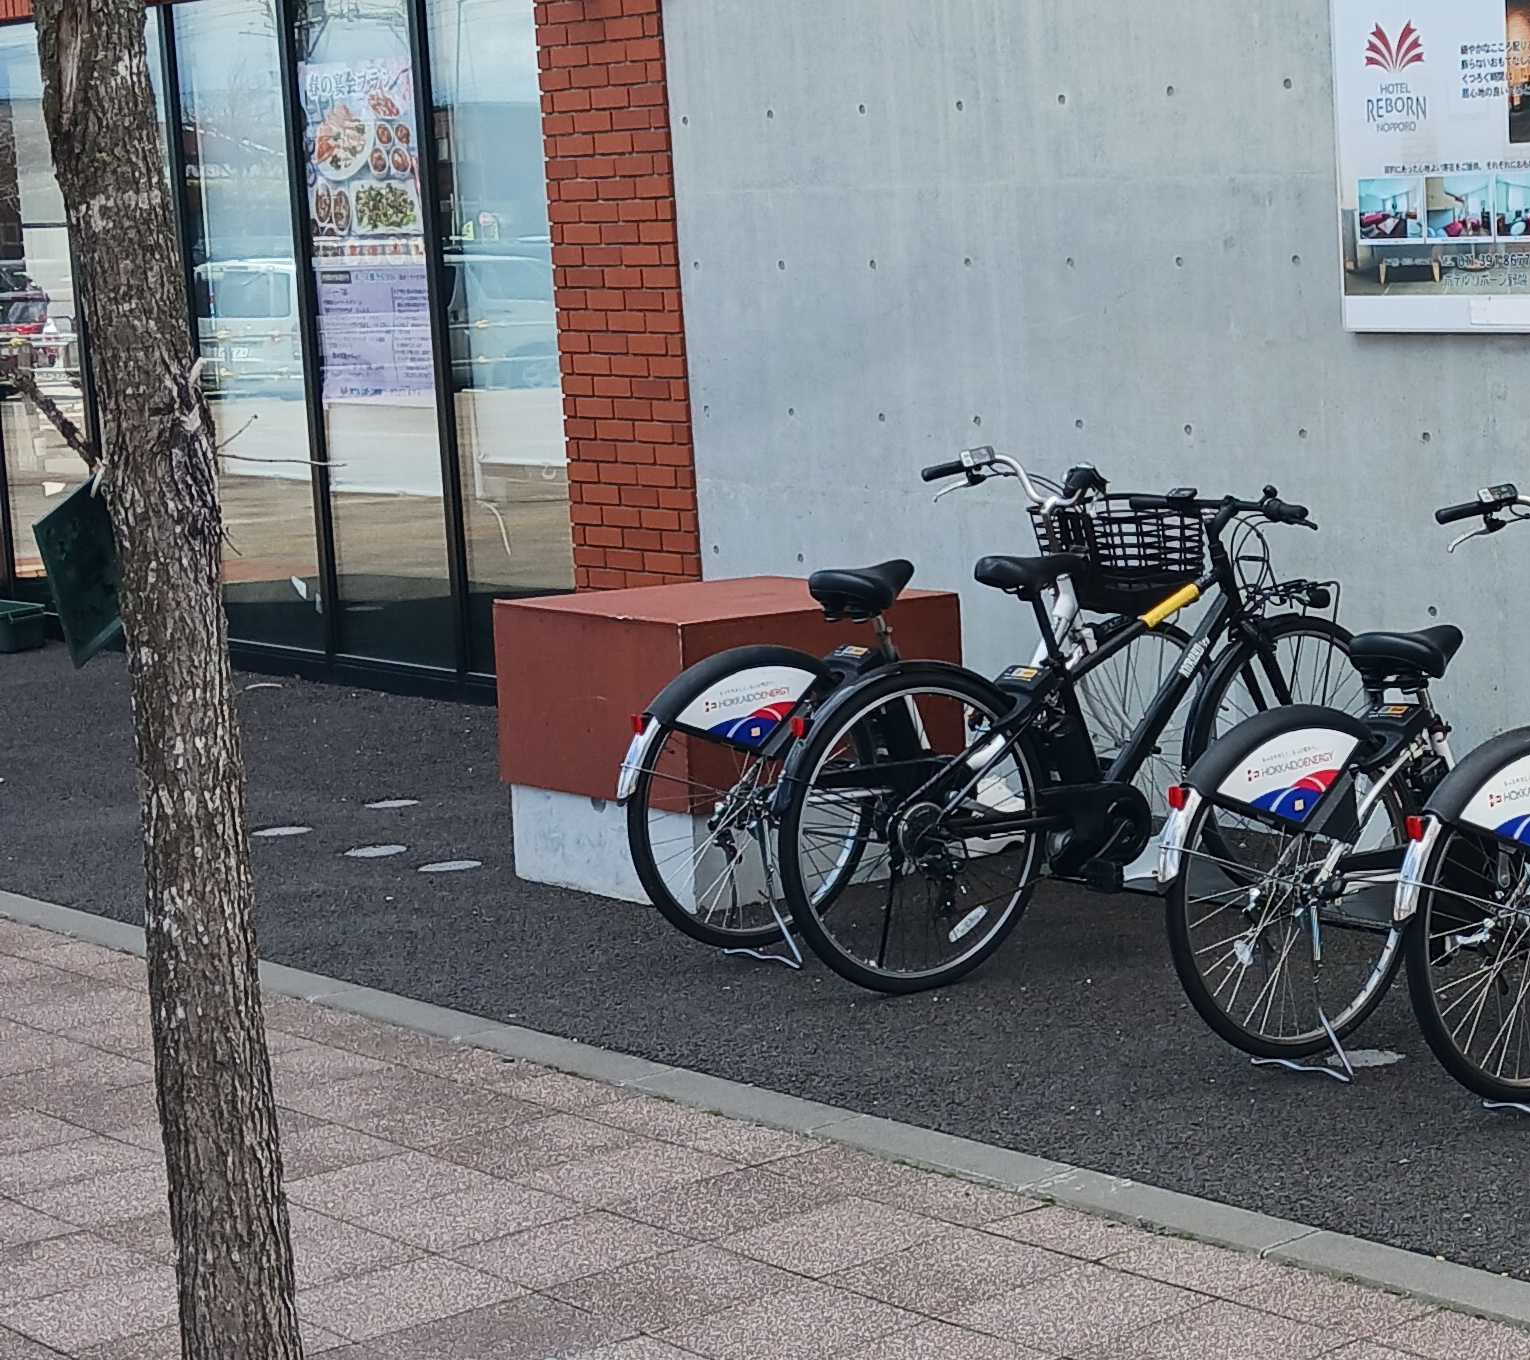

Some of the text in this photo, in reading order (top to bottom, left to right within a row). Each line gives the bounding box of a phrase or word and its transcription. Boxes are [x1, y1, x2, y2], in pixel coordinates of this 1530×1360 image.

[1379, 82, 1411, 95] HOTEL
[1366, 96, 1427, 123] REBORN
[1376, 121, 1417, 133] NOPPORO
